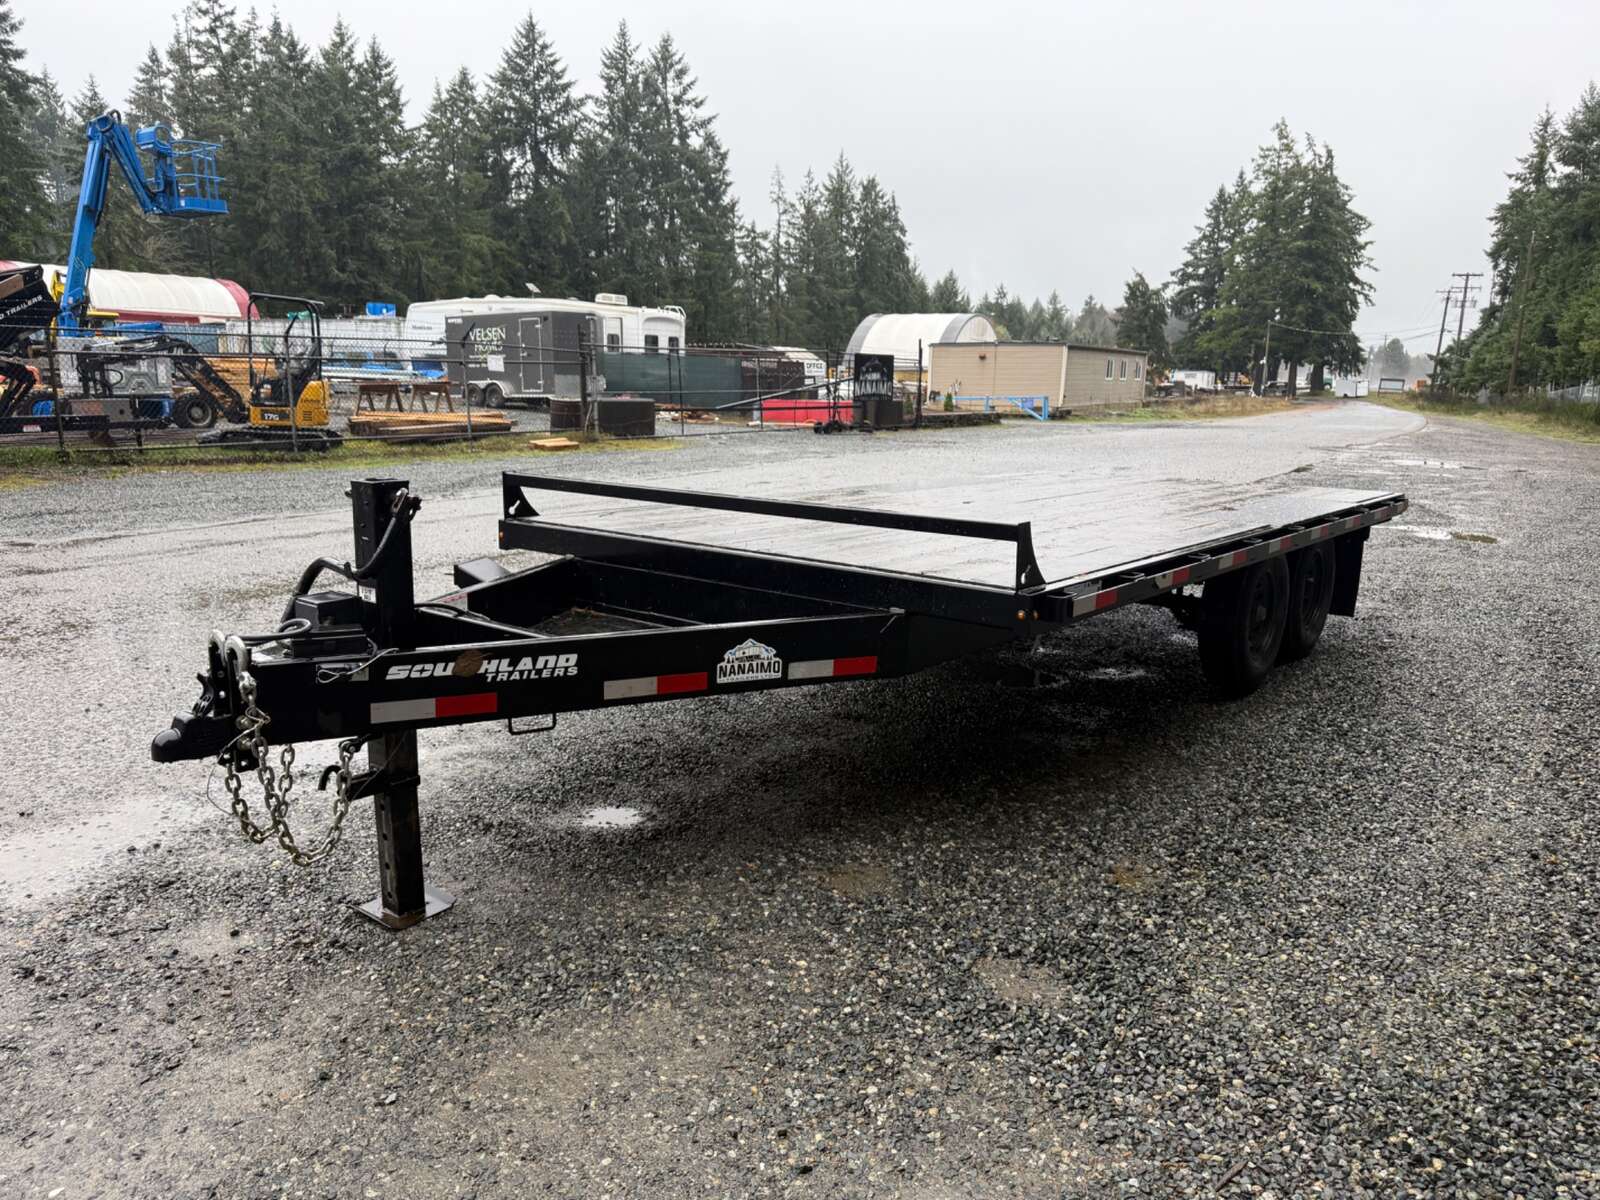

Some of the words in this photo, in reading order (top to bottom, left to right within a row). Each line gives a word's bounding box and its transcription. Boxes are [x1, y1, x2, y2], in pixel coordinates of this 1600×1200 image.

[5, 294, 43, 316] TRAILERS
[469, 327, 506, 341] VELSEN
[855, 380, 892, 397] NANAIMO
[385, 653, 578, 680] SOUHLAND
[486, 666, 578, 683] TRAILERS
[718, 660, 781, 680] NANAIMO
